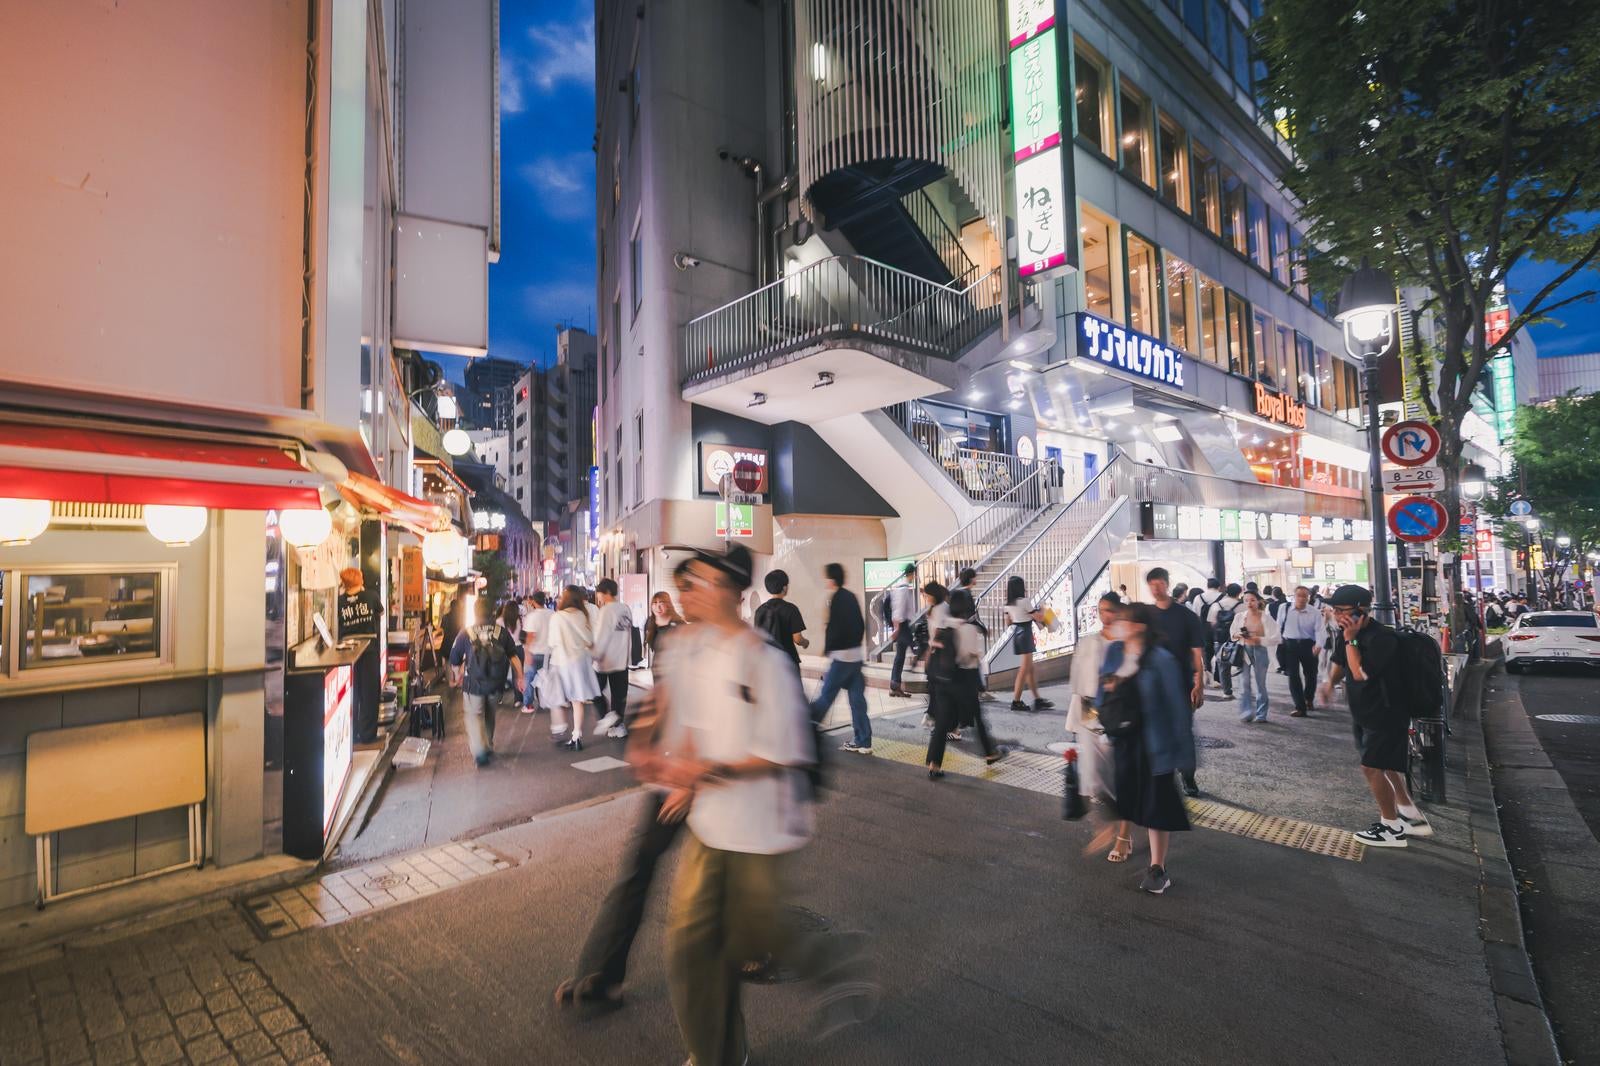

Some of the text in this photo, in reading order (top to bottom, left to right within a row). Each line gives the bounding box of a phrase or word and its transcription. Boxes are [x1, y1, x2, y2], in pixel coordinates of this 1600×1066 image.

[1024, 38, 1043, 139] モスバーガー
[1030, 138, 1045, 155] 1F
[1022, 186, 1053, 255] ねぎし
[1034, 258, 1049, 272] B1
[1083, 316, 1184, 386] サンマルクカフェ
[1254, 381, 1307, 430] Royal Host
